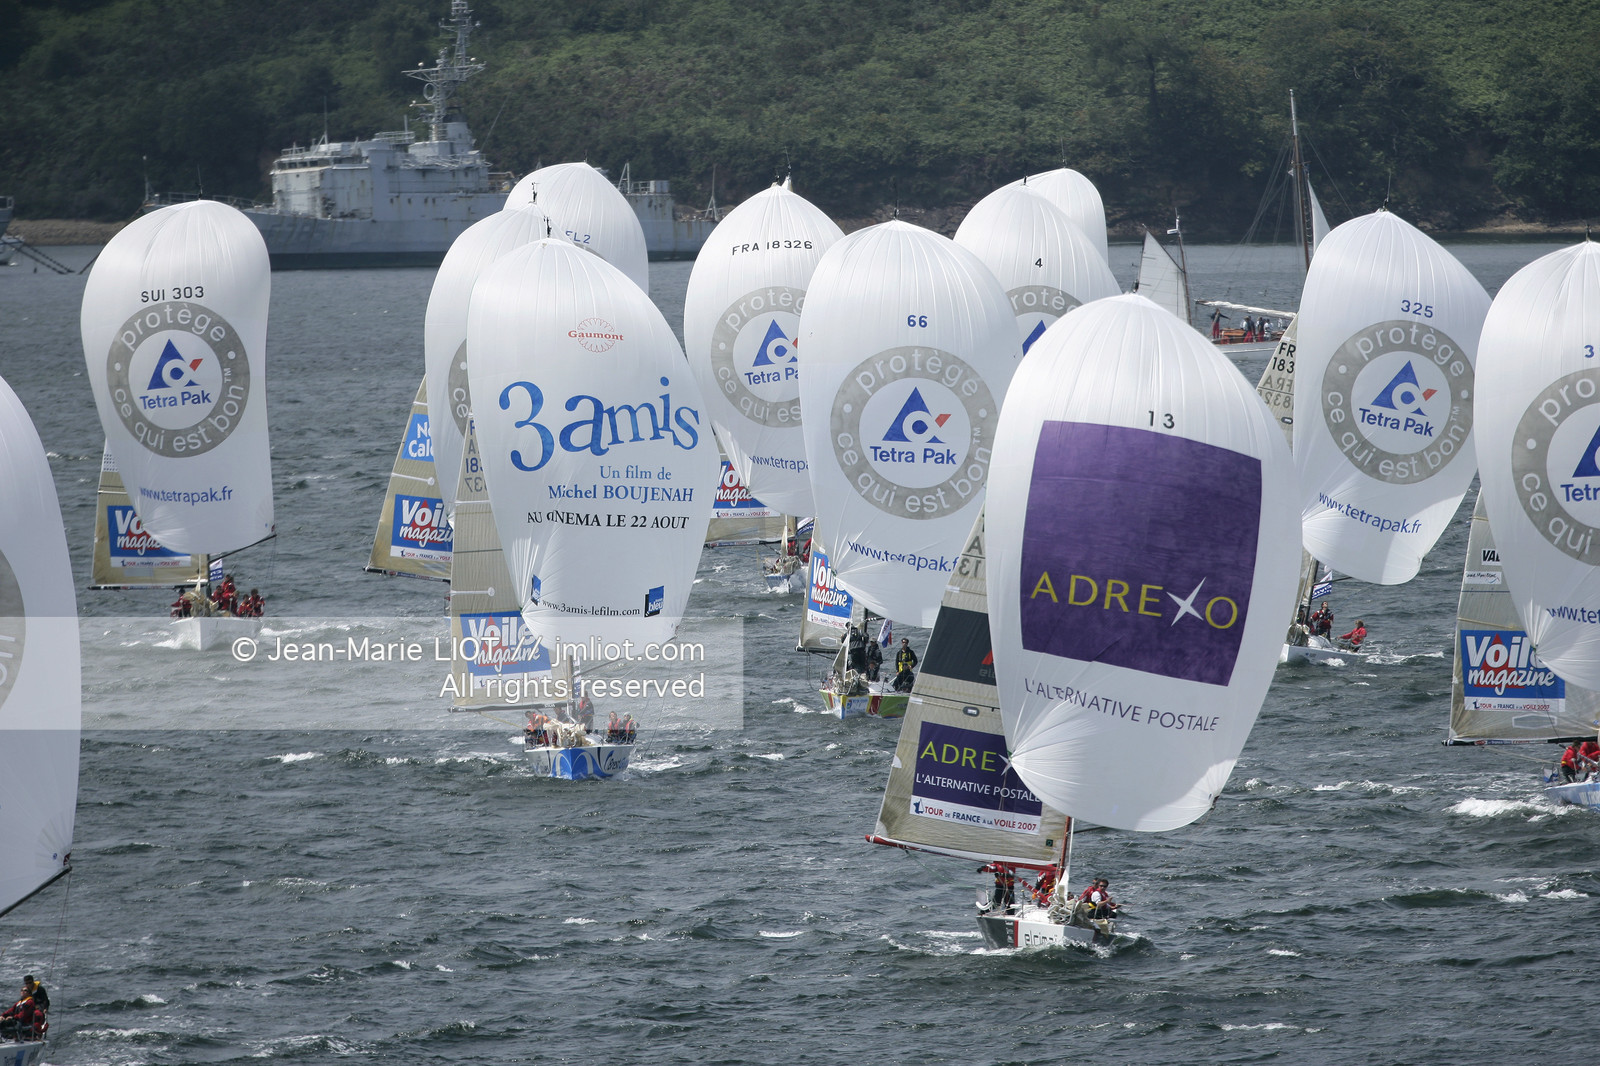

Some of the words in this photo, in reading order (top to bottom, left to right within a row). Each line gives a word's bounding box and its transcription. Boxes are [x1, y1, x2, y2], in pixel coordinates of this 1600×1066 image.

[732, 243, 759, 255] FRA
[766, 240, 813, 250] 18326
[1035, 258, 1043, 268] 4
[141, 288, 166, 302] SUI
[172, 286, 204, 300] 303
[1401, 299, 1434, 318] 325
[121, 303, 226, 351] protège
[907, 314, 928, 328] 66
[568, 330, 624, 341] Gaumont
[1355, 324, 1465, 377] protège
[744, 371, 781, 386] Tetra
[855, 348, 979, 397] protège
[140, 394, 178, 410] Tetra
[181, 390, 212, 405] Pak
[718, 366, 737, 394] ce
[740, 396, 769, 420] qui
[115, 388, 132, 418] ce
[135, 421, 165, 450] qui
[173, 427, 212, 452] est
[499, 381, 555, 472] 3
[559, 376, 701, 457] amis
[1359, 407, 1400, 430] Tetra
[1403, 417, 1434, 438] Pak
[1328, 391, 1345, 423] ce
[1341, 431, 1376, 467] qui
[1378, 456, 1419, 478] est
[466, 457, 483, 473] 18
[870, 445, 916, 464] Tetra
[923, 448, 957, 466] Pak
[600, 465, 620, 479] Un
[625, 465, 652, 479] film
[657, 467, 672, 480] de
[837, 432, 859, 466] ce
[857, 471, 899, 508] qui
[905, 487, 950, 513] est
[140, 485, 233, 506] www.tetrapak.fr
[548, 484, 597, 499] Michel
[603, 485, 694, 504] BOUJENAH
[527, 511, 543, 524] AU
[605, 514, 626, 527] LE
[630, 515, 647, 528] 22
[650, 516, 690, 529] AOUT
[1319, 491, 1422, 534] www.tetrapak.fr
[1522, 472, 1547, 512] ce
[1549, 516, 1593, 555] qui
[542, 600, 640, 616] www.3amis-lefilm.com
[811, 586, 848, 611] magazine
[1030, 571, 1238, 630] ADREXO
[1468, 666, 1555, 695] magazine
[1147, 709, 1220, 732] POSTALE
[916, 772, 990, 795] L'ALTERNATIVE
[924, 806, 943, 817] TOUR
[952, 811, 980, 824] FRANCE
[993, 818, 1016, 829] VOILE
[1017, 821, 1037, 831] 2007
